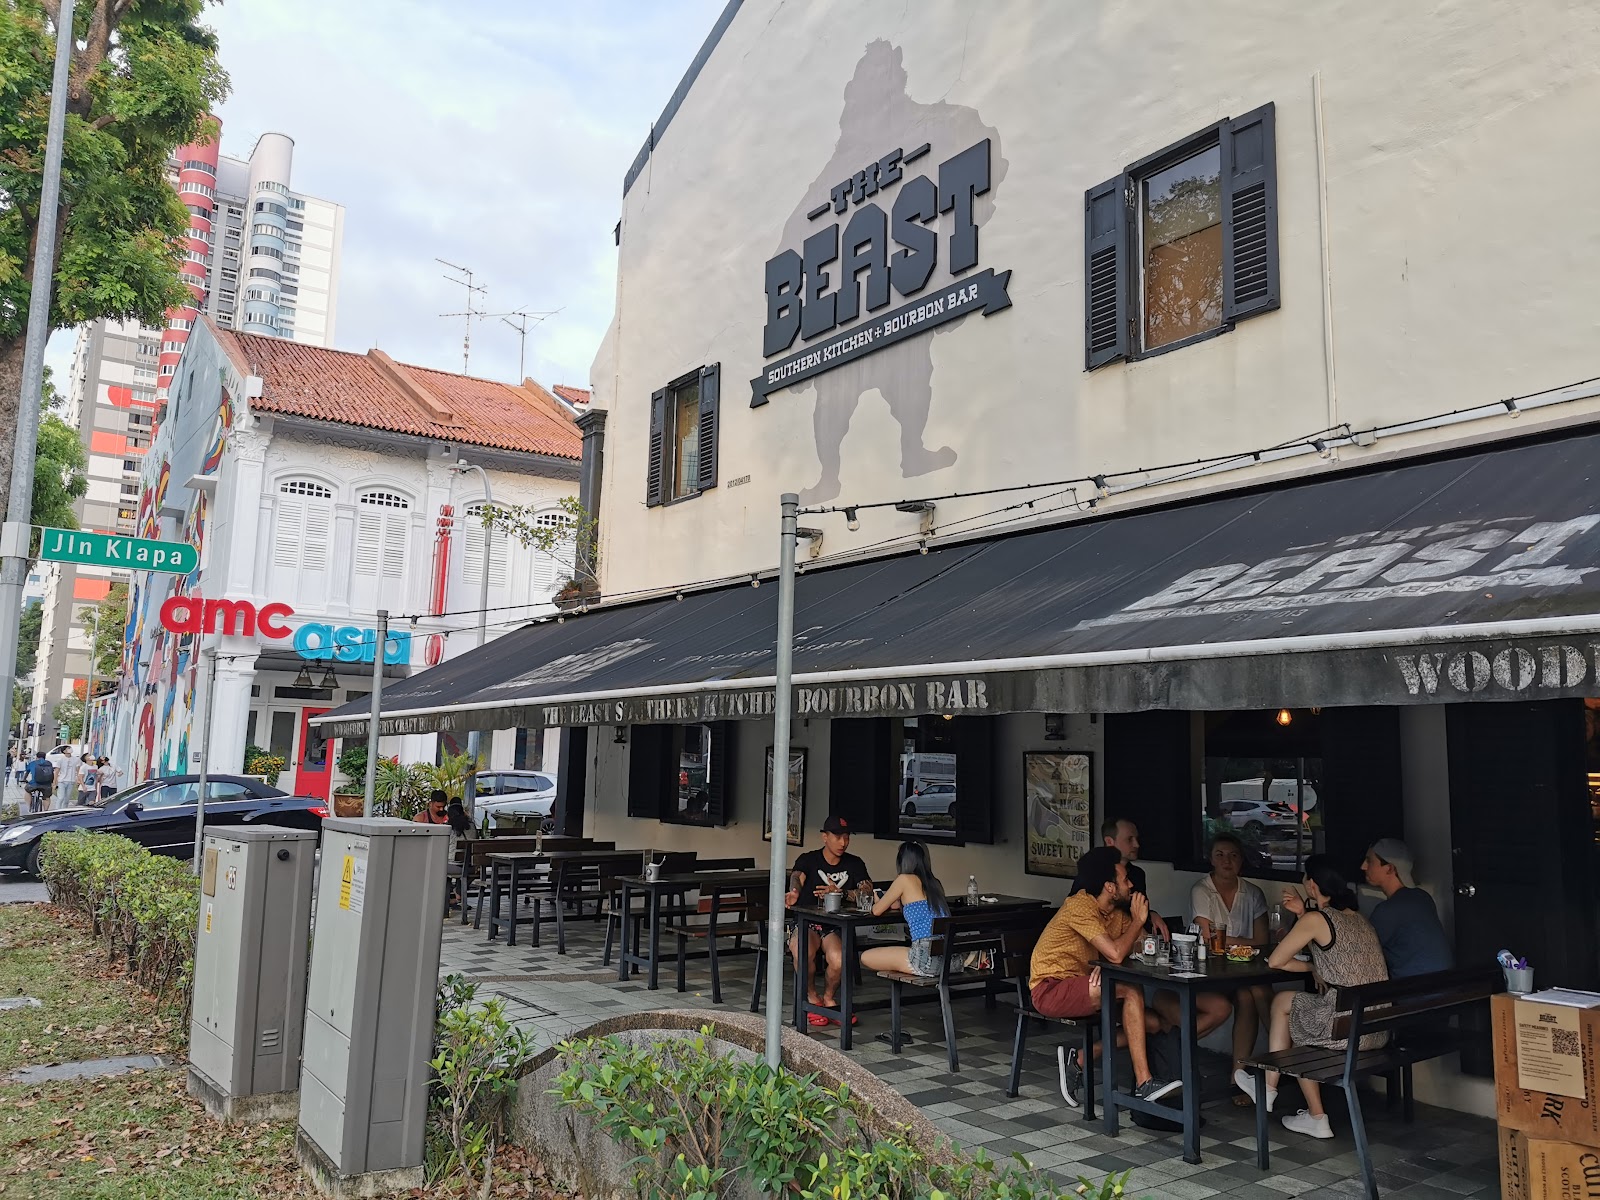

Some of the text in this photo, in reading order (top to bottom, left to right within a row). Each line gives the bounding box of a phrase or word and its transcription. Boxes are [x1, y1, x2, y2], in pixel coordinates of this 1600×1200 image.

[831, 147, 903, 215] THE
[763, 138, 991, 358] BEAST
[768, 350, 821, 384] SOUTHERN
[823, 328, 873, 362] KITCHEN
[883, 298, 944, 337] BOURBON
[947, 283, 978, 310] BAR
[51, 533, 182, 568] Jln Klapa
[1121, 513, 1600, 613] BEAST
[160, 595, 295, 639] amc
[292, 621, 412, 666] asia
[615, 695, 699, 722] STHERN
[703, 690, 776, 717] KITCHE
[797, 683, 917, 713] BOURBON
[925, 679, 989, 710] BAR
[395, 717, 418, 732] CRAFT
[1031, 842, 1064, 858] SWEET
[1541, 1092, 1565, 1125] RK
[1560, 1166, 1570, 1200] SCOTC
